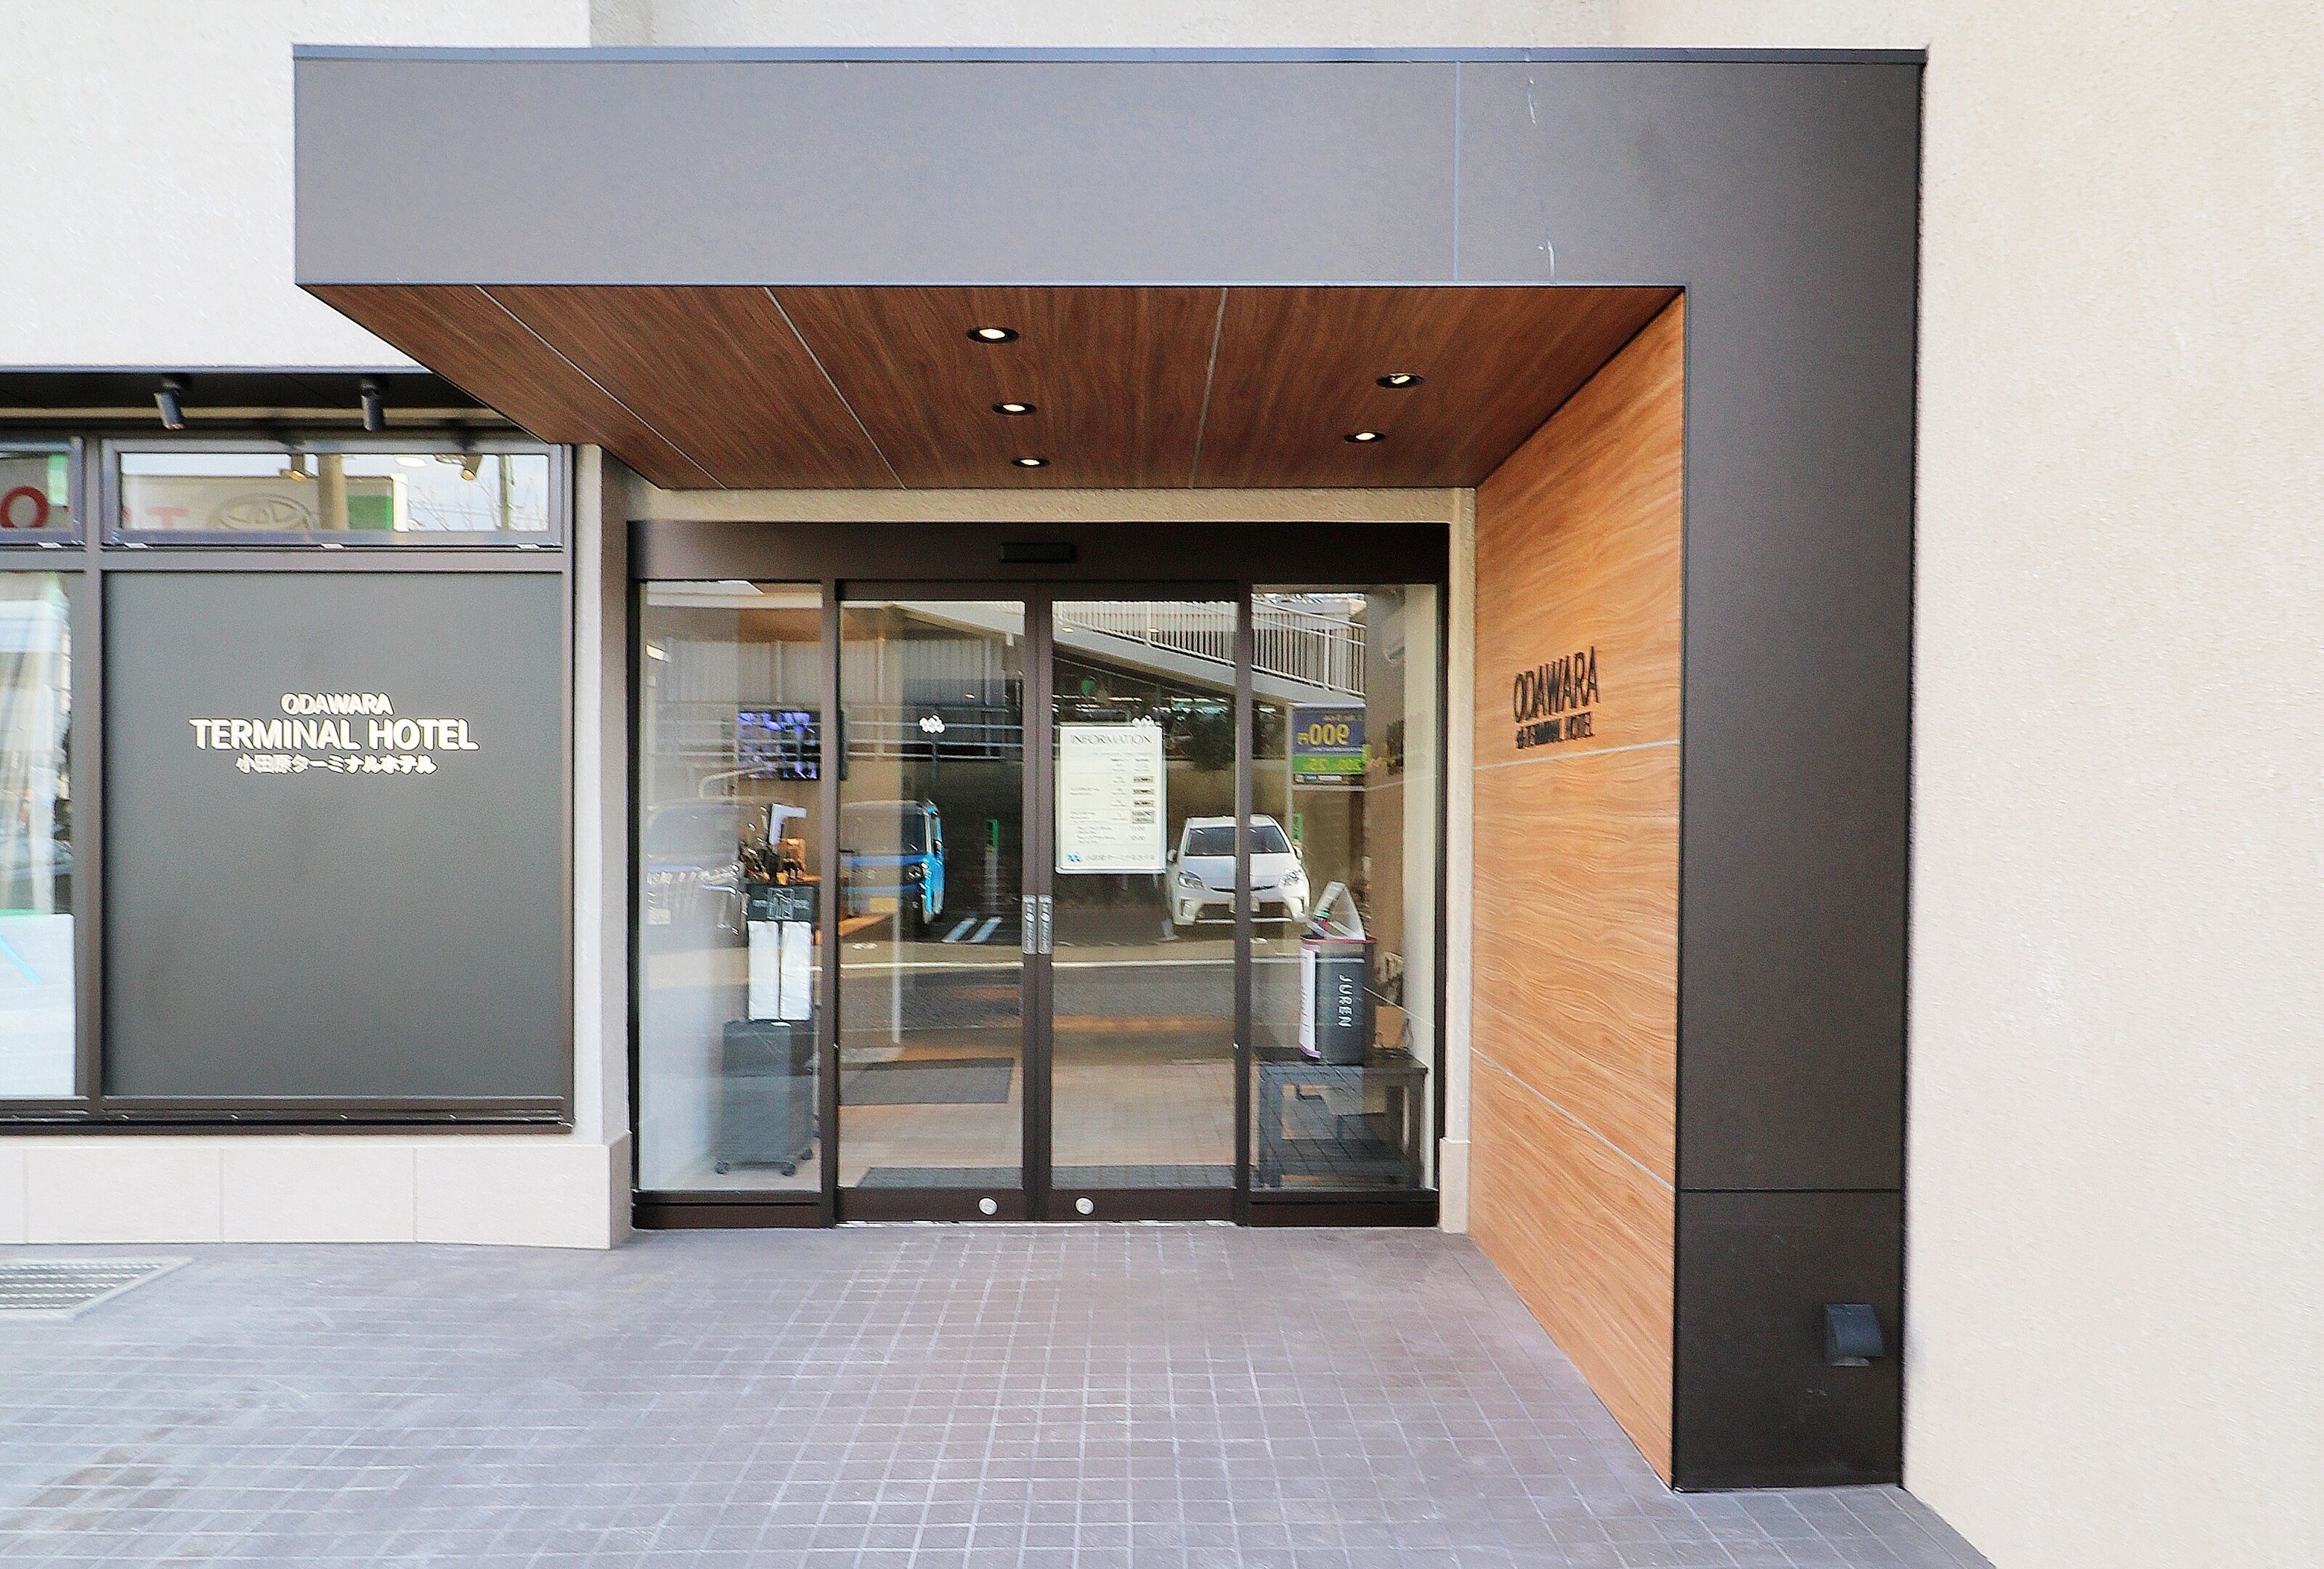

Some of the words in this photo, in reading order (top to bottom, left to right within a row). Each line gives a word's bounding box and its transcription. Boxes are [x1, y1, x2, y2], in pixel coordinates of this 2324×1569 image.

[1514, 645, 1601, 723] ODAWARA
[280, 692, 394, 715] ODAWARA
[189, 718, 362, 750] TERMINAL
[367, 718, 480, 750] HOTEL
[1070, 733, 1152, 745] INFORMATION
[236, 753, 438, 775] 小田原ターミナルホテル
[1338, 973, 1353, 1028] JUREN
